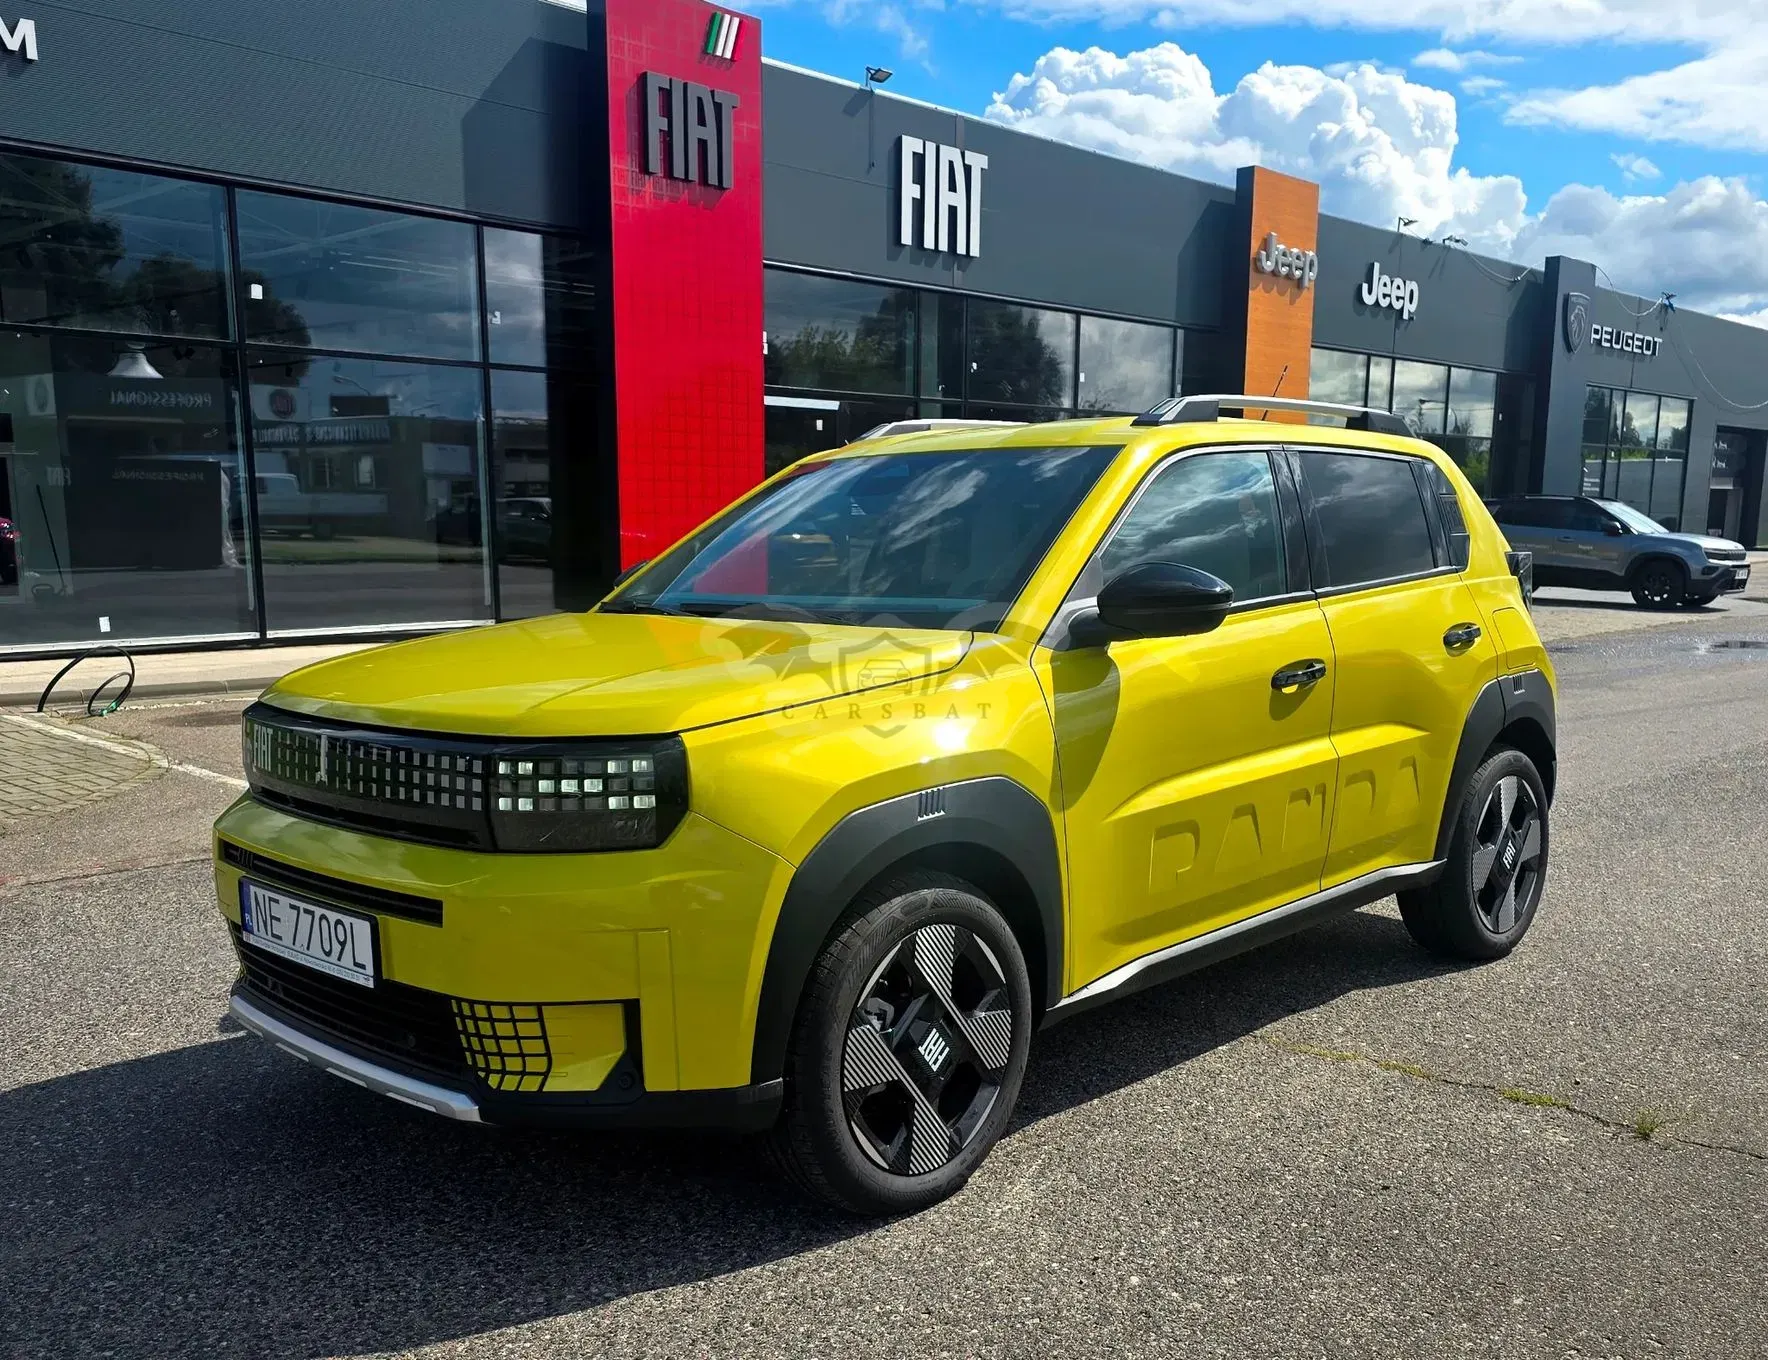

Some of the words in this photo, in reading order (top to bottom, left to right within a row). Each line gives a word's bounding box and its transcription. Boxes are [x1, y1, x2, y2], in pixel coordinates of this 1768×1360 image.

[645, 71, 740, 190] FIAT
[901, 134, 988, 258] FIAT
[1256, 232, 1318, 289] Jeep
[1362, 262, 1419, 320] Jeep
[1591, 324, 1663, 356] PEUGEOT
[253, 724, 274, 772] FIAT
[1149, 755, 1421, 893] PANDA
[1502, 840, 1516, 869] FIAT
[245, 913, 253, 926] PL
[254, 891, 283, 942] NE
[289, 903, 367, 971] 7709L
[917, 1027, 951, 1072] FIAT
